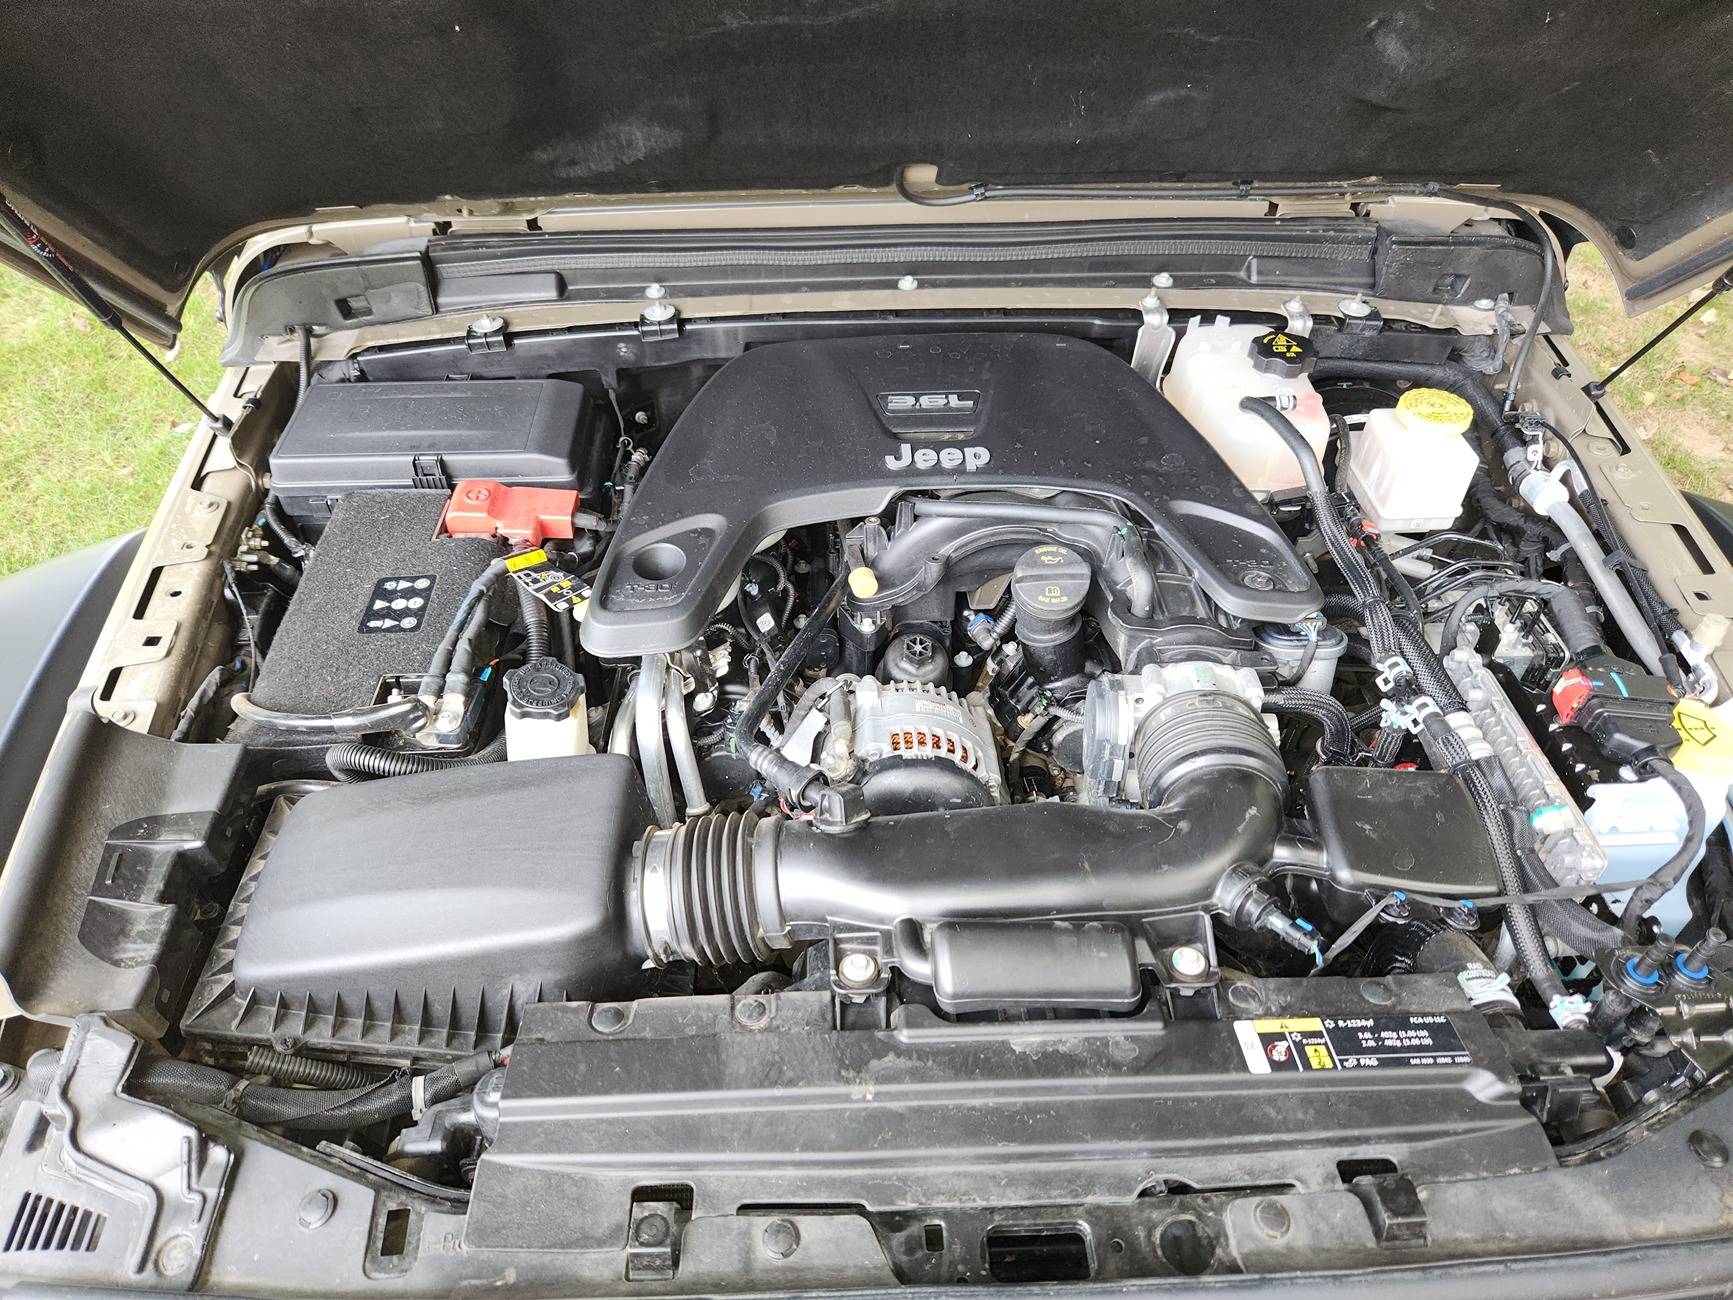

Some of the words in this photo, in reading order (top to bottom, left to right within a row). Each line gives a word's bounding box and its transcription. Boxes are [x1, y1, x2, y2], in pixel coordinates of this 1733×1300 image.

[887, 394, 974, 409] 3.6L
[884, 443, 991, 472] Jeep
[1035, 546, 1057, 554] ENGINE
[1058, 547, 1068, 555] OIL
[537, 662, 571, 676] APPROVED
[523, 698, 561, 706] STEERING
[1338, 1018, 1374, 1028] R-1234yf
[1359, 1058, 1379, 1067] PAG
